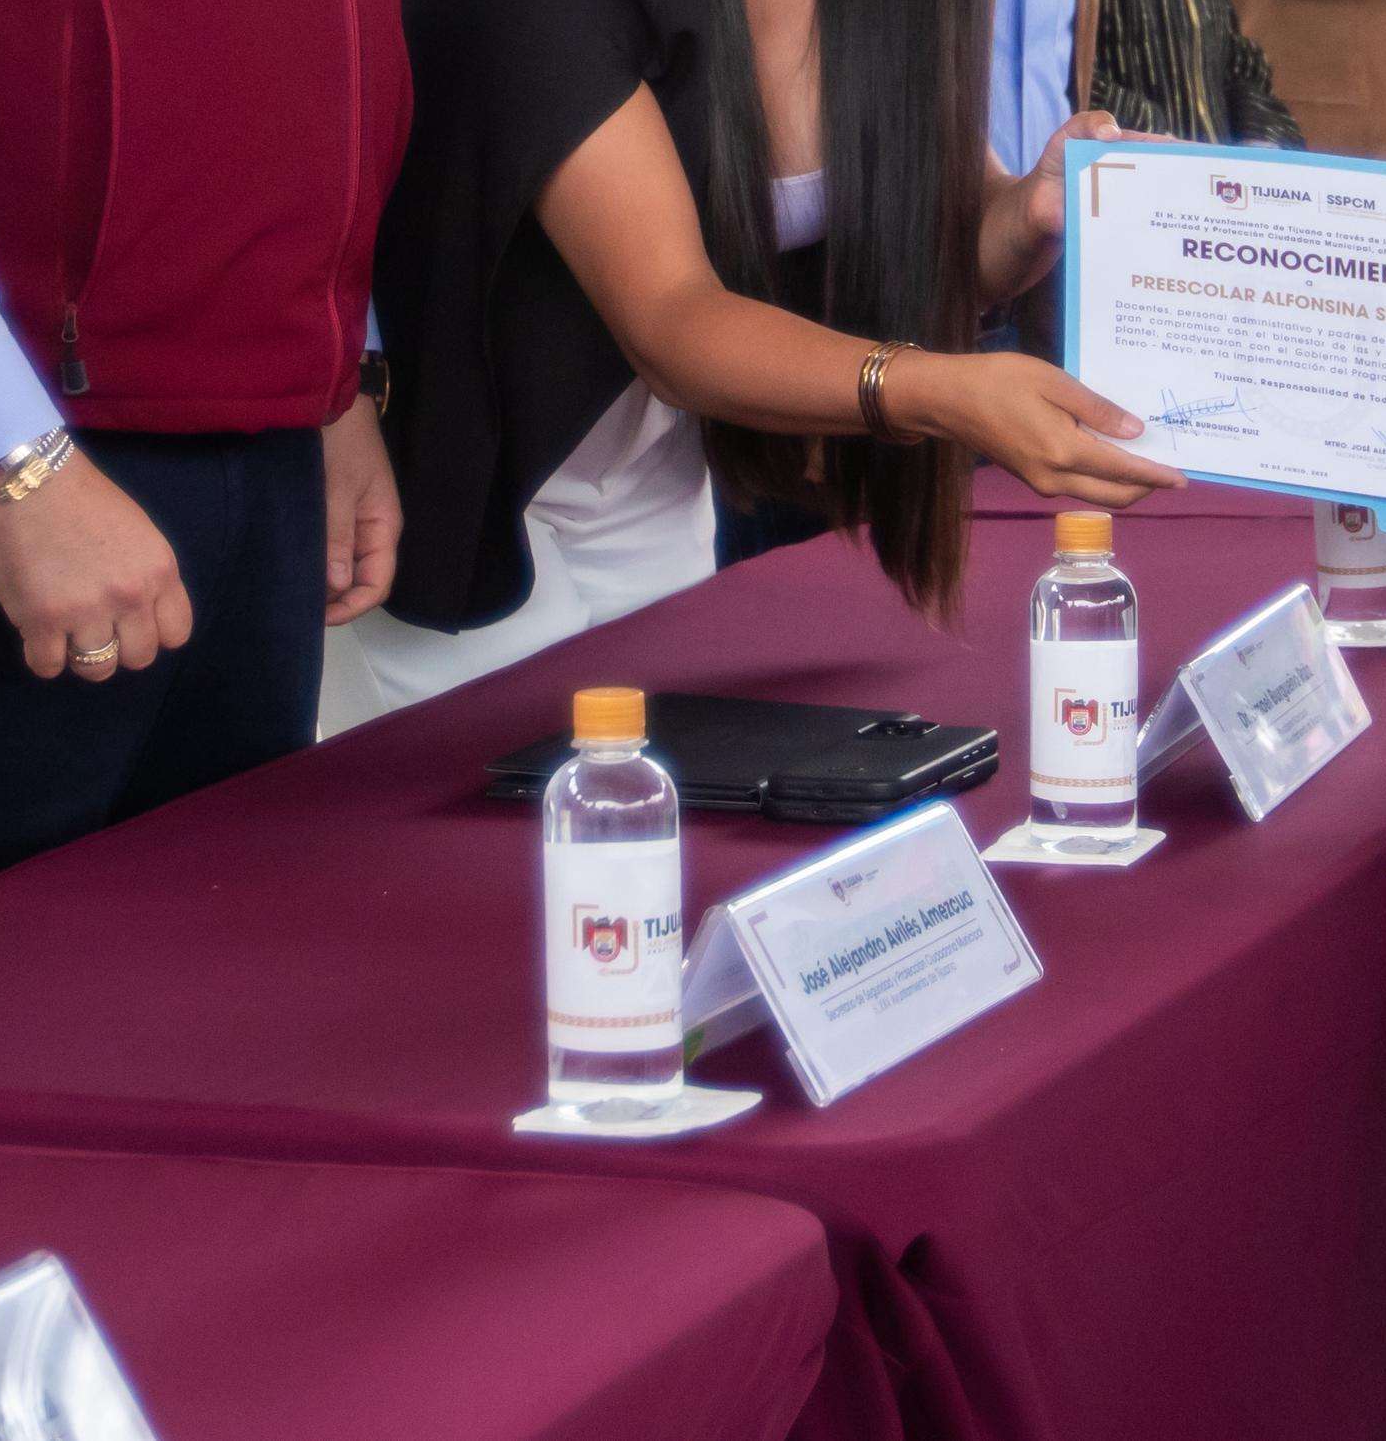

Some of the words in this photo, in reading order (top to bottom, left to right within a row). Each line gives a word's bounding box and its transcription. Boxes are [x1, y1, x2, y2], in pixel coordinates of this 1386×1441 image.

[1251, 186, 1312, 202] TIJUANA
[1327, 194, 1376, 210] SSPCM
[1150, 220, 1200, 231] Seguridad
[1213, 226, 1264, 238] Protección
[1268, 233, 1321, 246] Ciudadana
[1204, 216, 1269, 229] Ayuntamiento
[1273, 221, 1285, 231] de
[1288, 225, 1322, 236] Tijuana
[1131, 275, 1256, 302] PREESCOLAR
[1263, 291, 1369, 319] ALFONSINA
[1305, 279, 1313, 287] a
[1115, 300, 1172, 315] Docentes,
[1177, 309, 1227, 321] personal
[1232, 315, 1312, 334] administrativo
[1328, 330, 1367, 341] padres
[1371, 334, 1385, 344] de
[1115, 314, 1142, 323] gran
[1149, 317, 1220, 333] compromiso
[1227, 327, 1248, 337] con
[1272, 332, 1325, 347] bienestar
[1332, 341, 1346, 351] de
[1115, 337, 1147, 348] Enero
[1162, 342, 1197, 355] Mayo,
[1200, 348, 1214, 356] en
[1234, 352, 1325, 372] implementación
[1330, 366, 1348, 376] del
[1165, 331, 1242, 348] coadyuvaron
[1249, 342, 1270, 352] con
[1294, 347, 1347, 363] Gobierno
[1214, 371, 1256, 386] Tijuana,
[1260, 379, 1349, 398] Responsabilidad
[1353, 391, 1366, 400] de
[1111, 699, 1137, 718] TIJU
[644, 911, 681, 939] TIJU
[798, 960, 830, 995] José
[827, 935, 888, 980] Alejandro
[884, 915, 923, 949] Avilés
[918, 889, 975, 930] Amezcua
